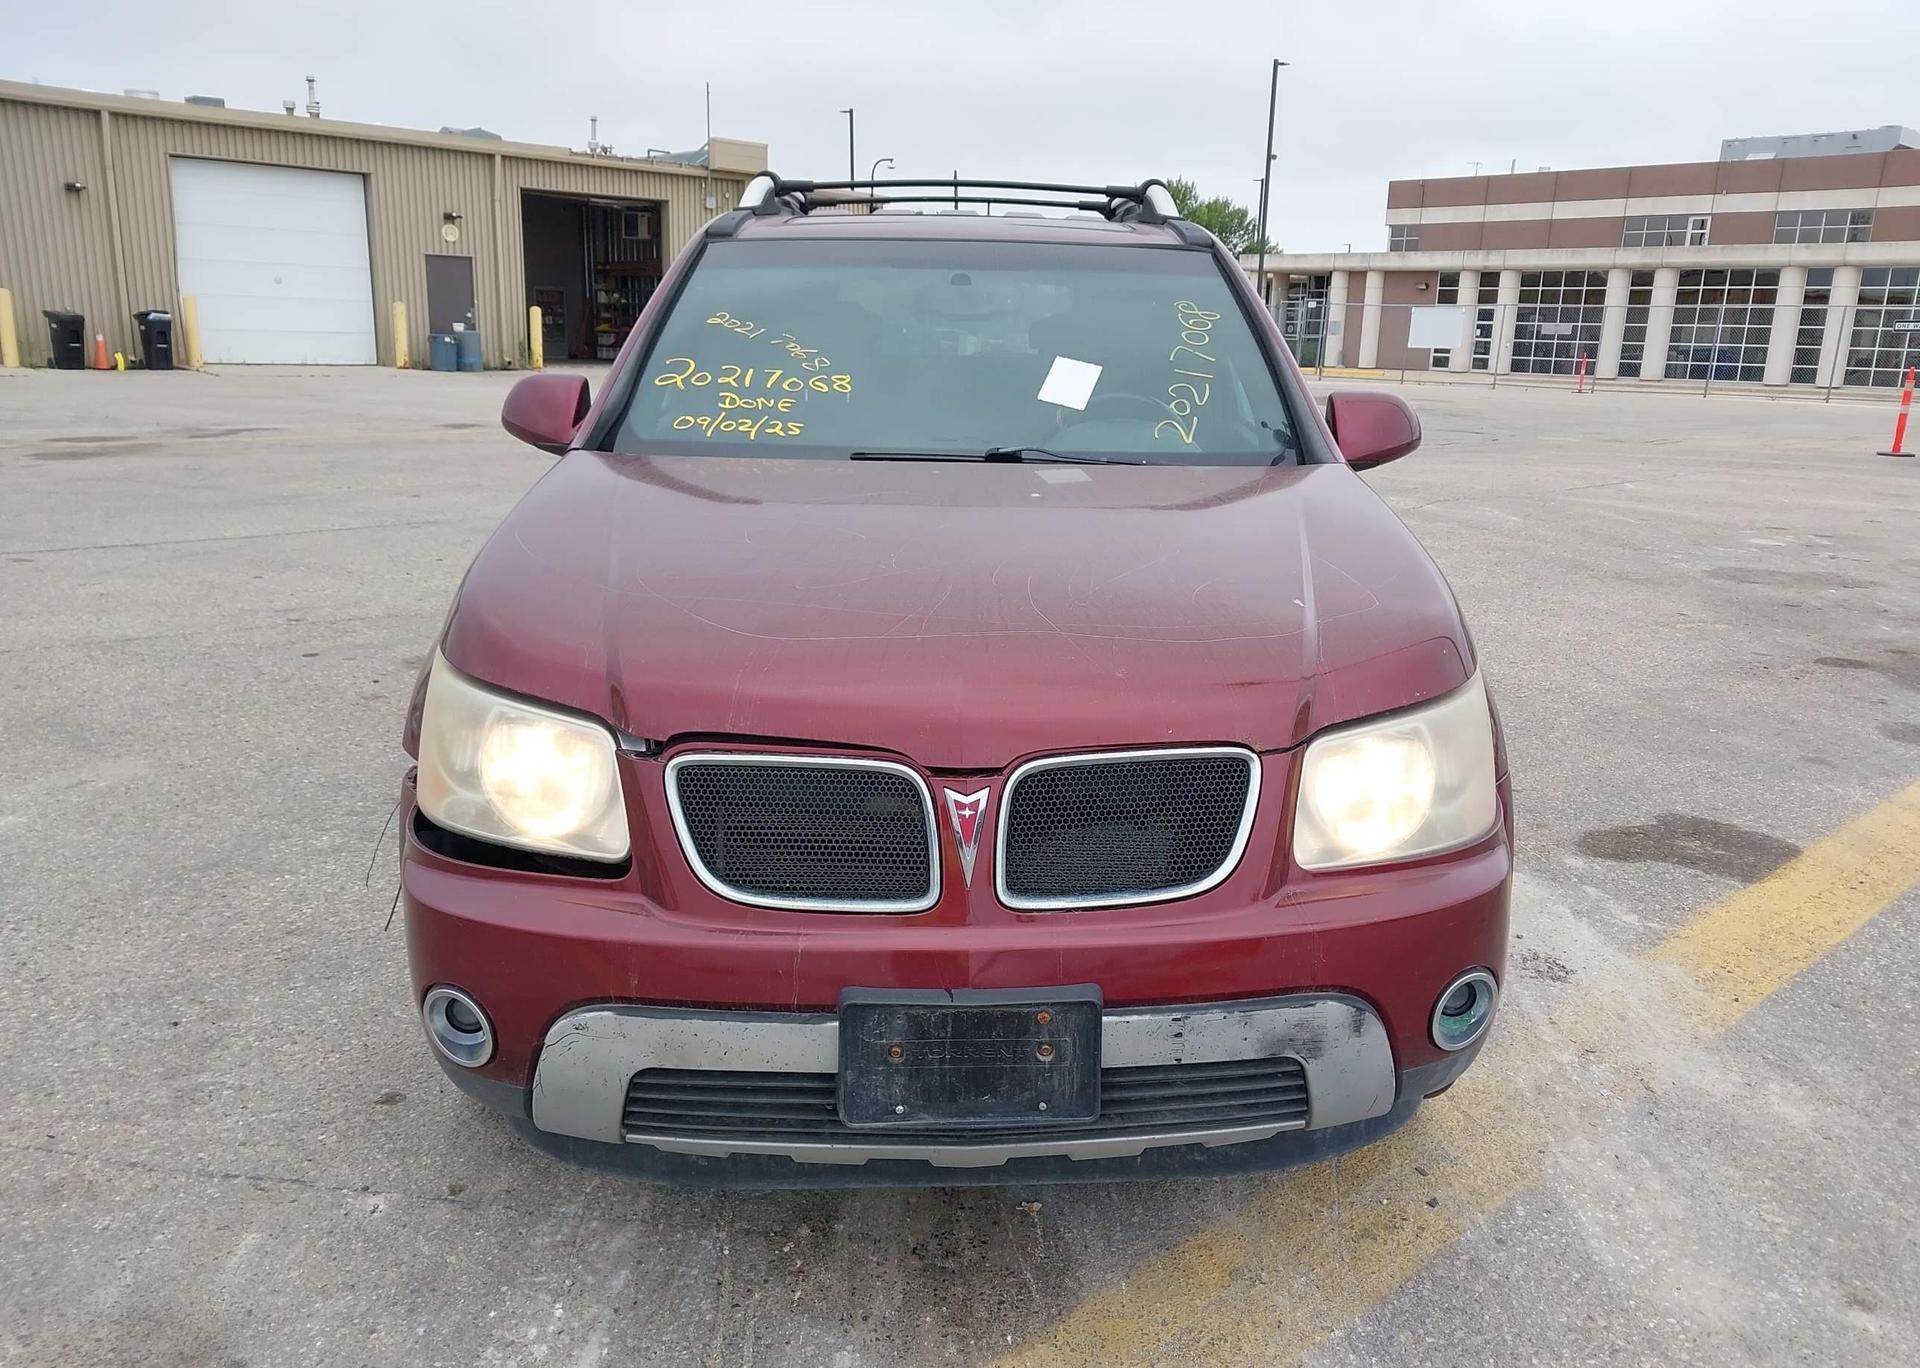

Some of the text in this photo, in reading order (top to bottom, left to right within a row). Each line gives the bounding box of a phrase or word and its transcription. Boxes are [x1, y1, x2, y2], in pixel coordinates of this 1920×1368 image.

[706, 311, 766, 339] 2021
[654, 358, 852, 393] 20217068
[1154, 300, 1221, 444] 20217068
[718, 392, 797, 412] DONE
[673, 412, 805, 440] 09/02/25
